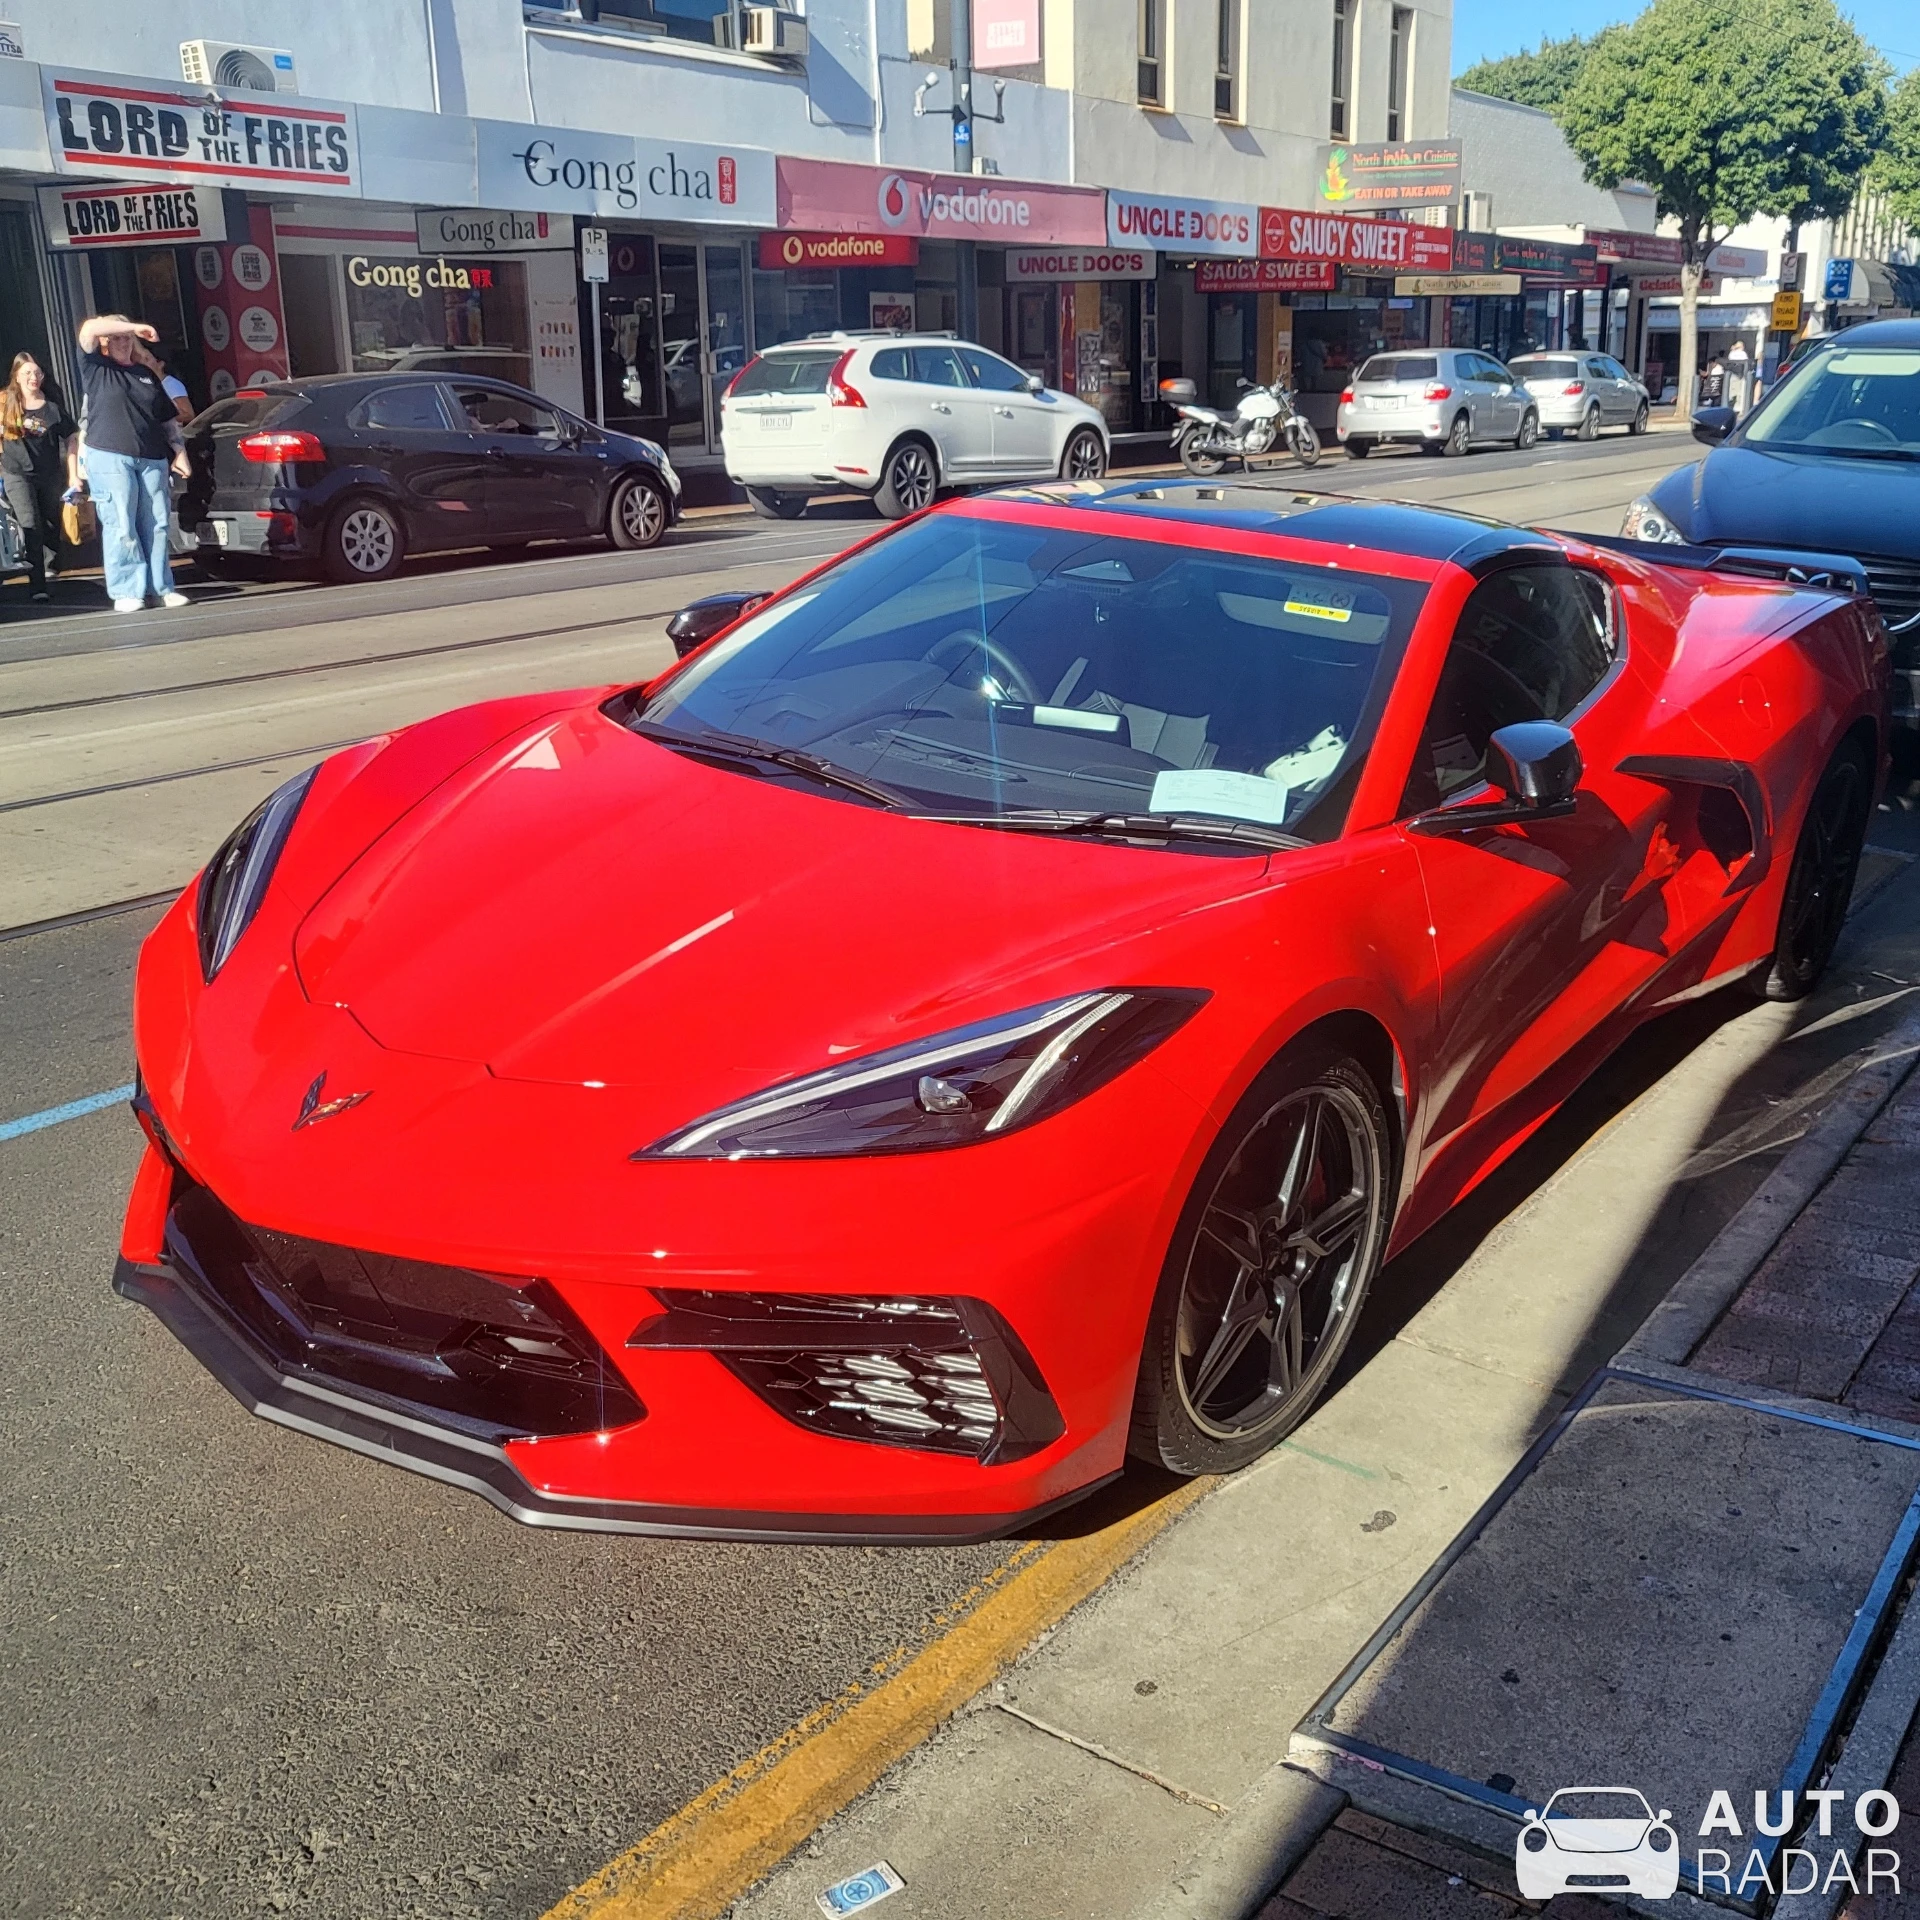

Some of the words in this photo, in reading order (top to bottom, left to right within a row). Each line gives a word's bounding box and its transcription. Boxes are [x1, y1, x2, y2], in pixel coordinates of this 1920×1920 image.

[55, 97, 189, 157] LORD
[203, 111, 232, 136] OF
[197, 137, 241, 163] THE
[245, 117, 349, 172] FRIES
[520, 140, 638, 209] Gong
[649, 152, 712, 199] cha
[1354, 188, 1372, 200] EAT
[1373, 188, 1384, 198] IN
[1385, 187, 1398, 198] OR
[1400, 186, 1424, 198] TAKE
[1424, 185, 1453, 197] AWAY
[63, 199, 121, 236] LORD
[124, 196, 137, 213] OF
[143, 191, 199, 231] FRIES
[919, 187, 1030, 226] vodafone
[124, 215, 144, 232] THE
[440, 216, 495, 249] Gong
[500, 213, 535, 240] cha
[1118, 204, 1185, 238] UNCLE
[1190, 211, 1249, 243] DOC'S
[1289, 215, 1350, 257] SAUCY
[1351, 222, 1408, 262] SWEET
[807, 236, 884, 258] vodafone
[1018, 256, 1079, 274] UNCLE
[1083, 254, 1143, 273] DOC'S
[348, 256, 422, 298] Gong
[425, 258, 471, 289] cha
[1203, 263, 1262, 281] SAUCY
[1265, 262, 1329, 279] SWEET
